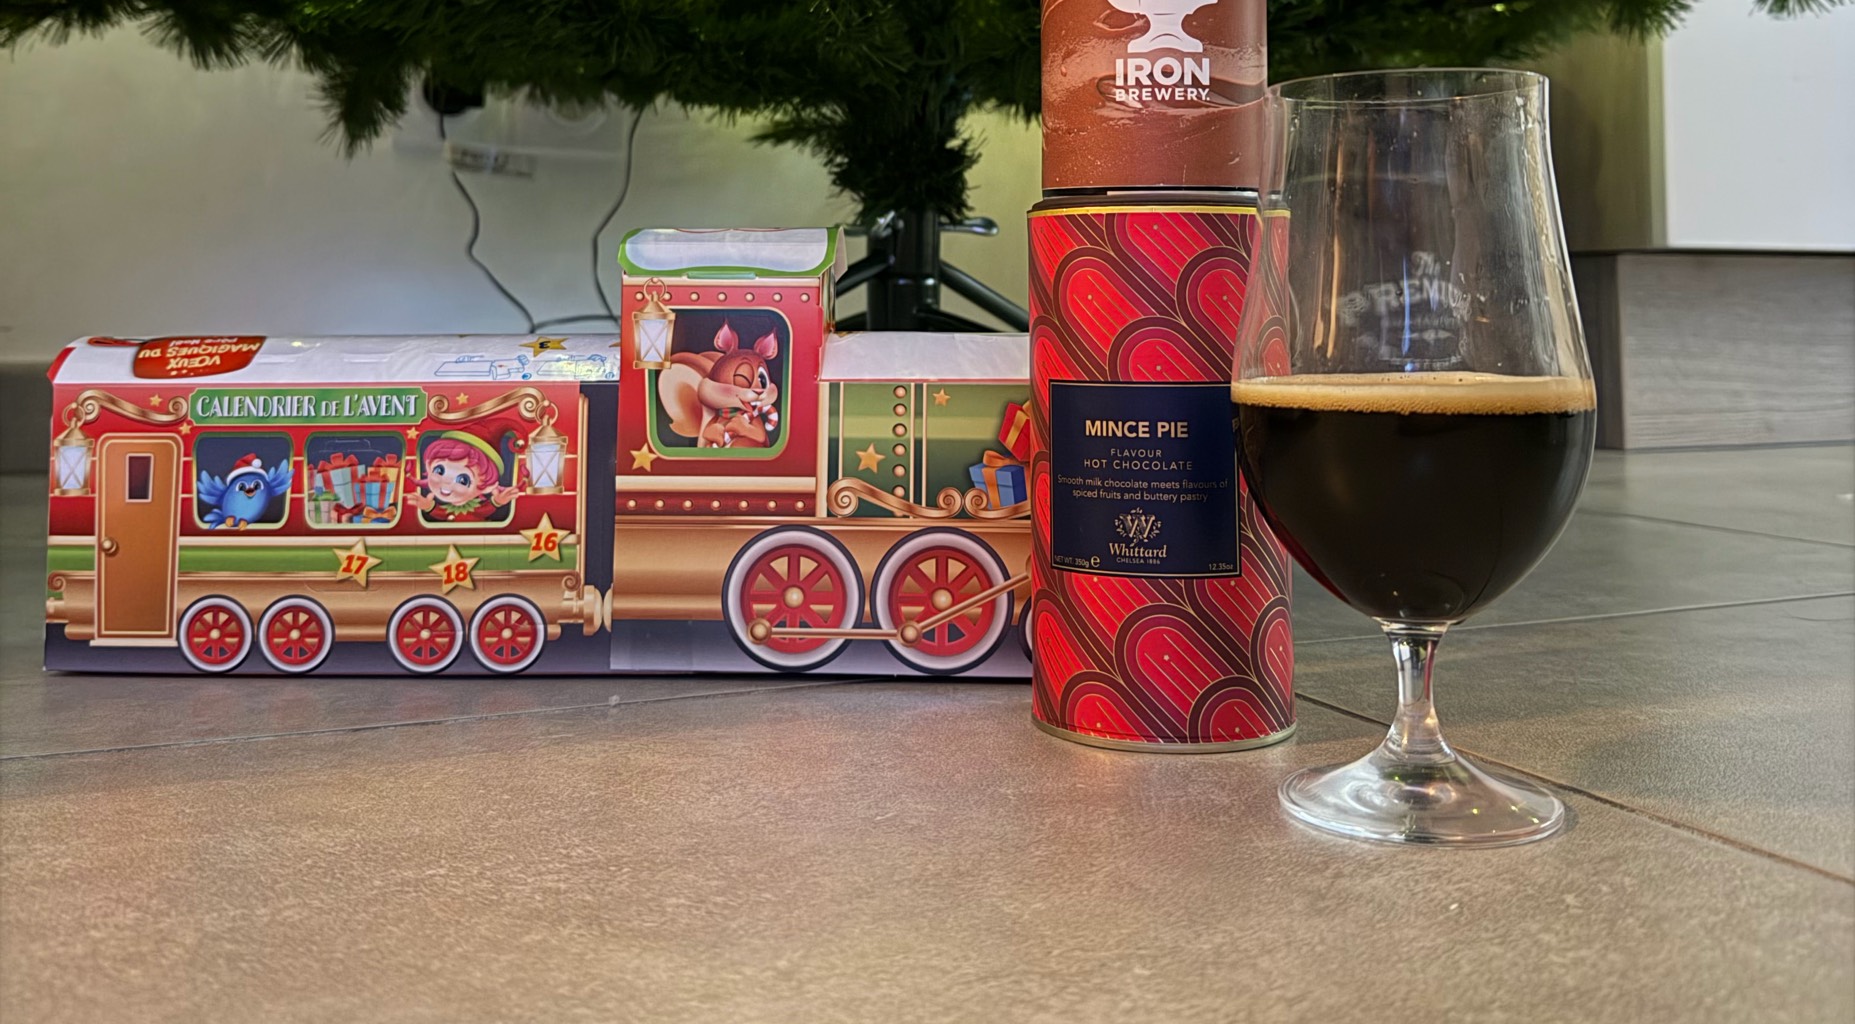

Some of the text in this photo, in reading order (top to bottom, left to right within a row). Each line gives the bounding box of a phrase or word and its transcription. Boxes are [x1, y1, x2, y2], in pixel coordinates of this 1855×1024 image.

[1115, 56, 1210, 86] IRON
[138, 342, 261, 359] MAGIQUES DU
[196, 394, 316, 417] CALENDRIER
[343, 394, 419, 417] L'AVENT
[1085, 419, 1189, 438] MINCE PIE
[1110, 448, 1162, 458] FLAVOUR
[1084, 459, 1193, 471] HOT CHOCOLATE
[1057, 474, 1229, 489] Smooth milk chocolate meets flavours of
[1072, 488, 1209, 504] spiced fruits and buttery pastry
[531, 532, 558, 553] 16
[1109, 542, 1167, 558] Whittard
[341, 554, 369, 575] 17
[1075, 558, 1090, 568] 350g
[1208, 563, 1234, 571] 12.35oz
[443, 561, 468, 585] 18
